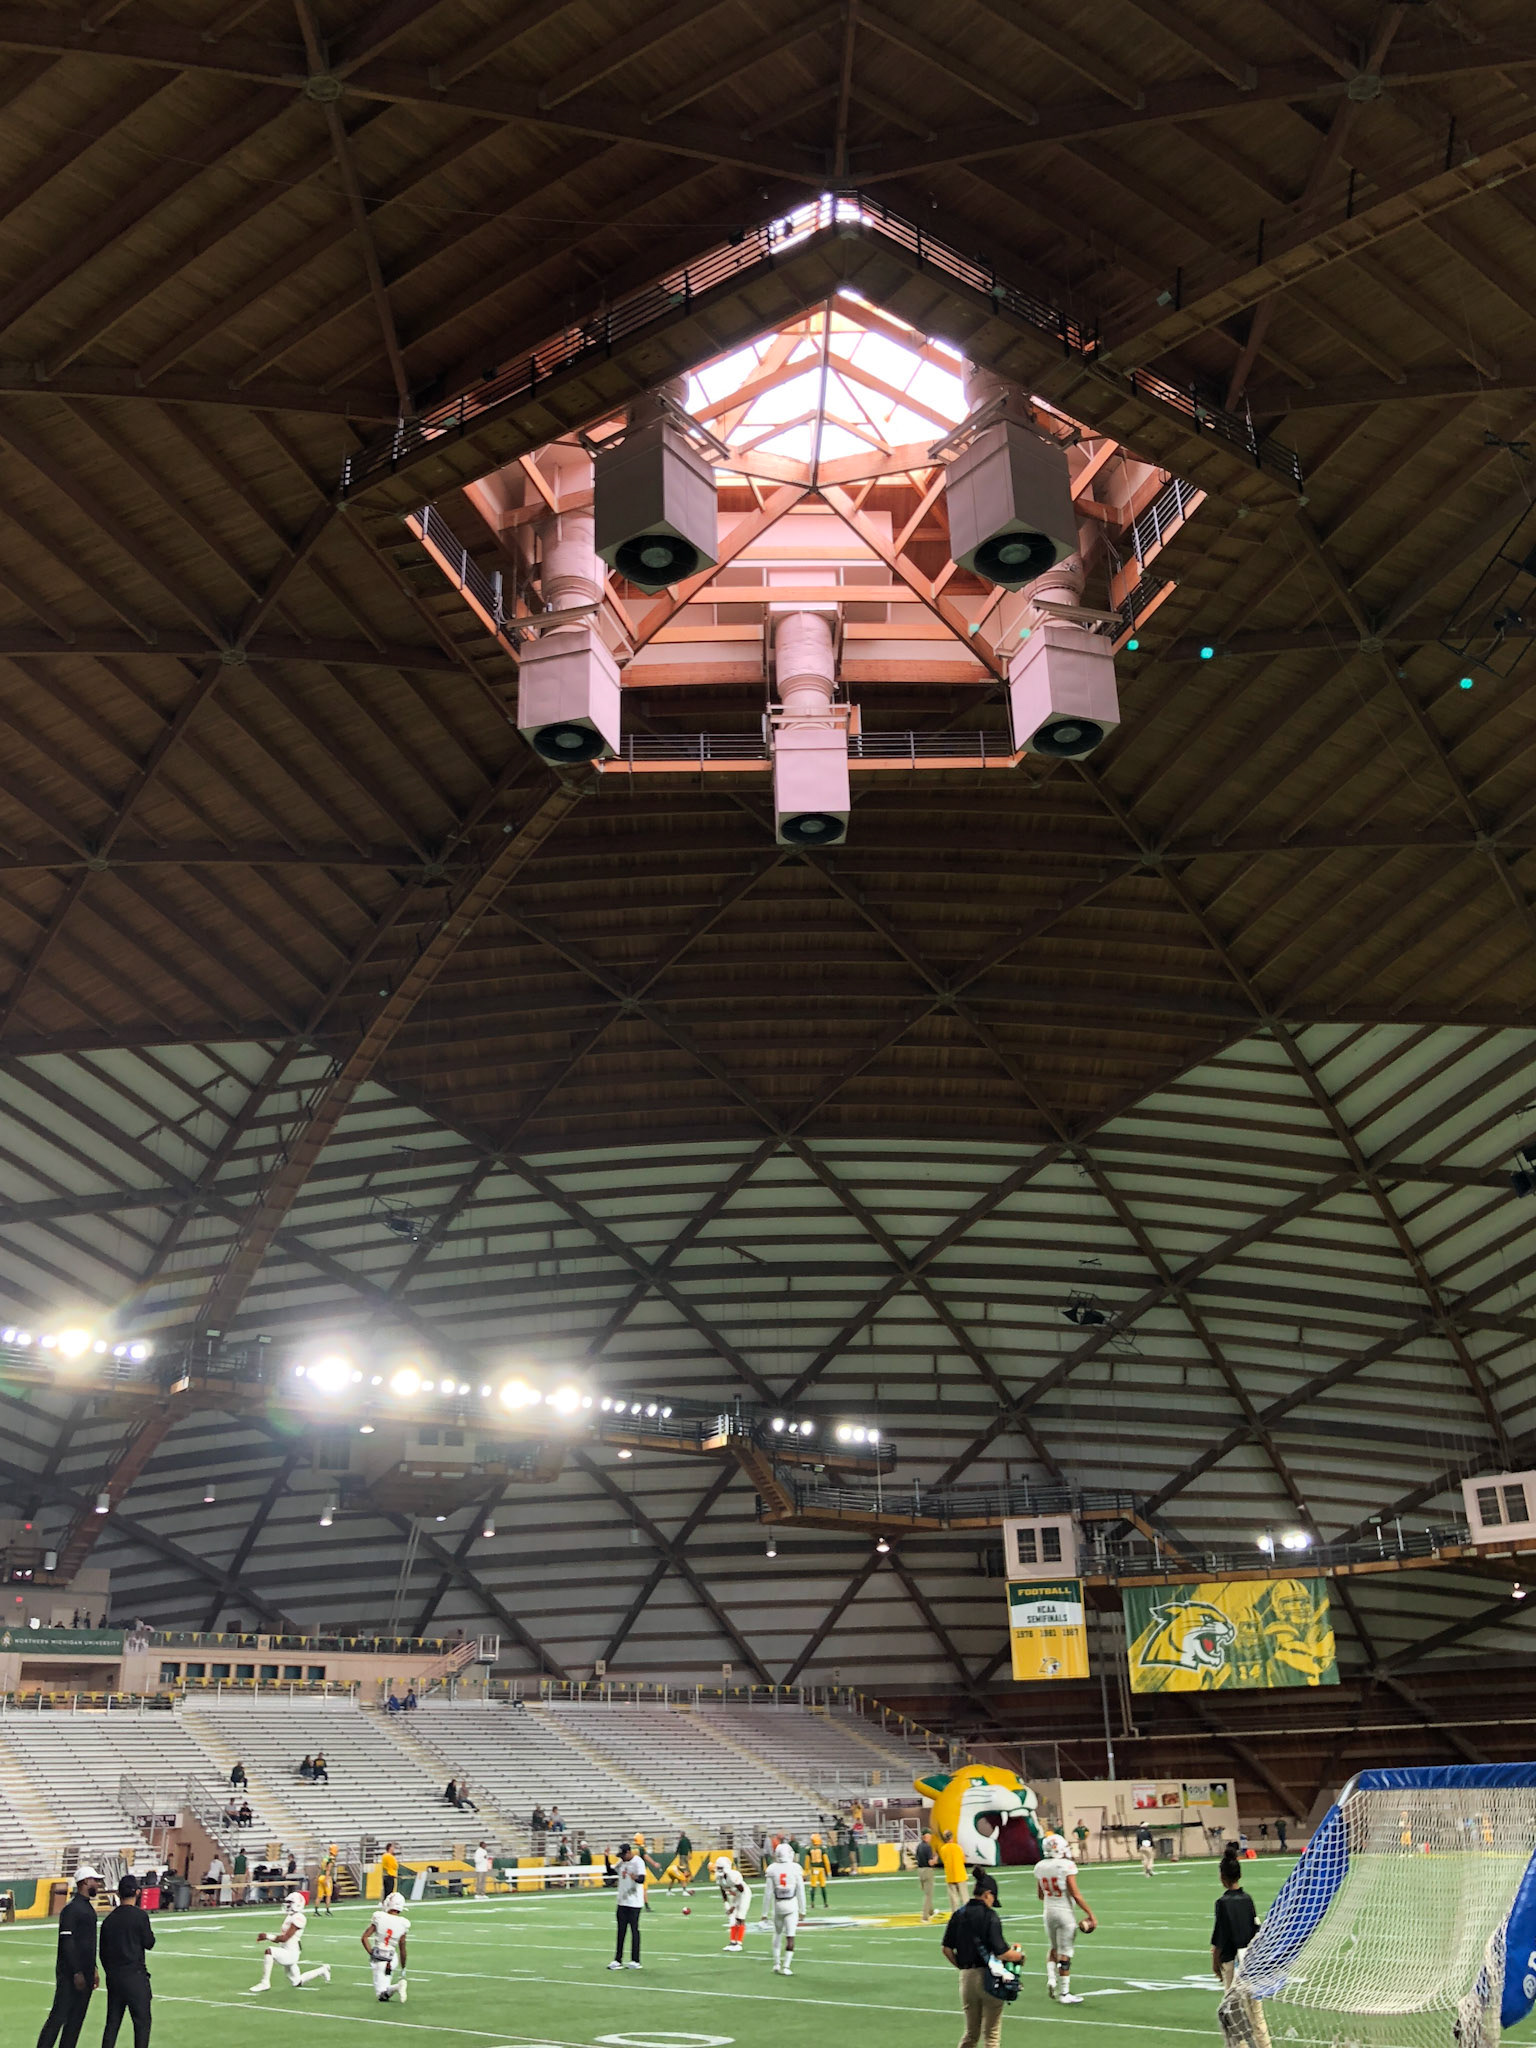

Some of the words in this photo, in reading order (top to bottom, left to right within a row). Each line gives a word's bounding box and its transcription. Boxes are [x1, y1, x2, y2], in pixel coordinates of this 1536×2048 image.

[1017, 1587, 1072, 1596] FOOTBALL
[1037, 1605, 1057, 1614] NCAA
[1027, 1614, 1068, 1624] SEMIFINALS
[14, 1637, 49, 1645] NORTHERN
[84, 1639, 120, 1647] UNIVERSITY
[779, 1872, 787, 1887] 5
[1041, 1876, 1062, 1898] 95
